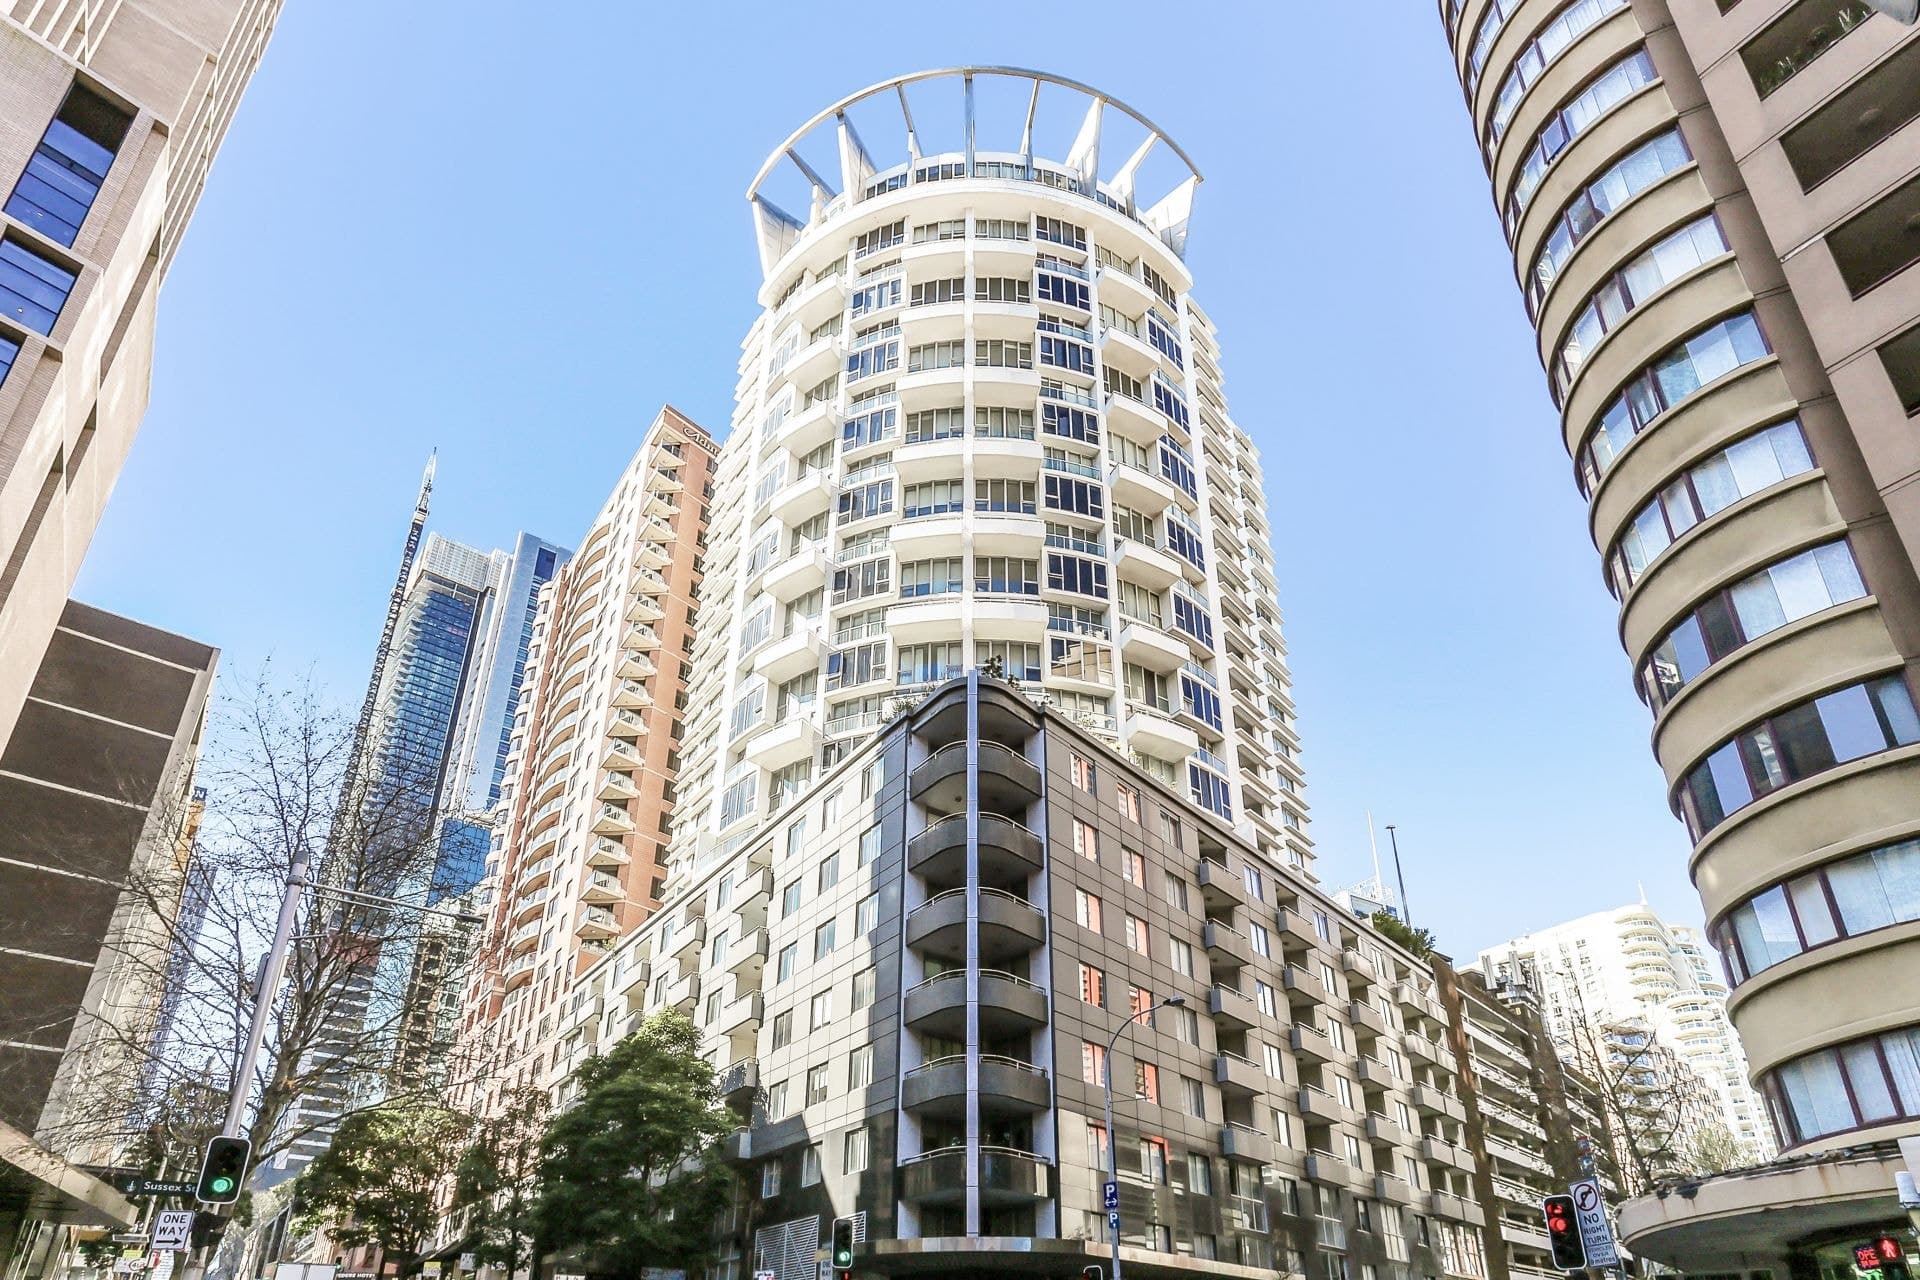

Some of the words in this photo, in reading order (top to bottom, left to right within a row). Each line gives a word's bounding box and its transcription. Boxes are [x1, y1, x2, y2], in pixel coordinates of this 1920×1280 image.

[682, 427, 721, 457] Adin
[144, 1181, 181, 1192] Sussex
[1106, 1184, 1115, 1197] P
[163, 1214, 188, 1224] ONE
[1110, 1212, 1118, 1224] P
[1583, 1213, 1600, 1225] NO
[159, 1226, 187, 1236] WAY
[1584, 1225, 1606, 1235] RIGHT
[1587, 1234, 1608, 1244] TURN
[1857, 1249, 1877, 1260] OPE
